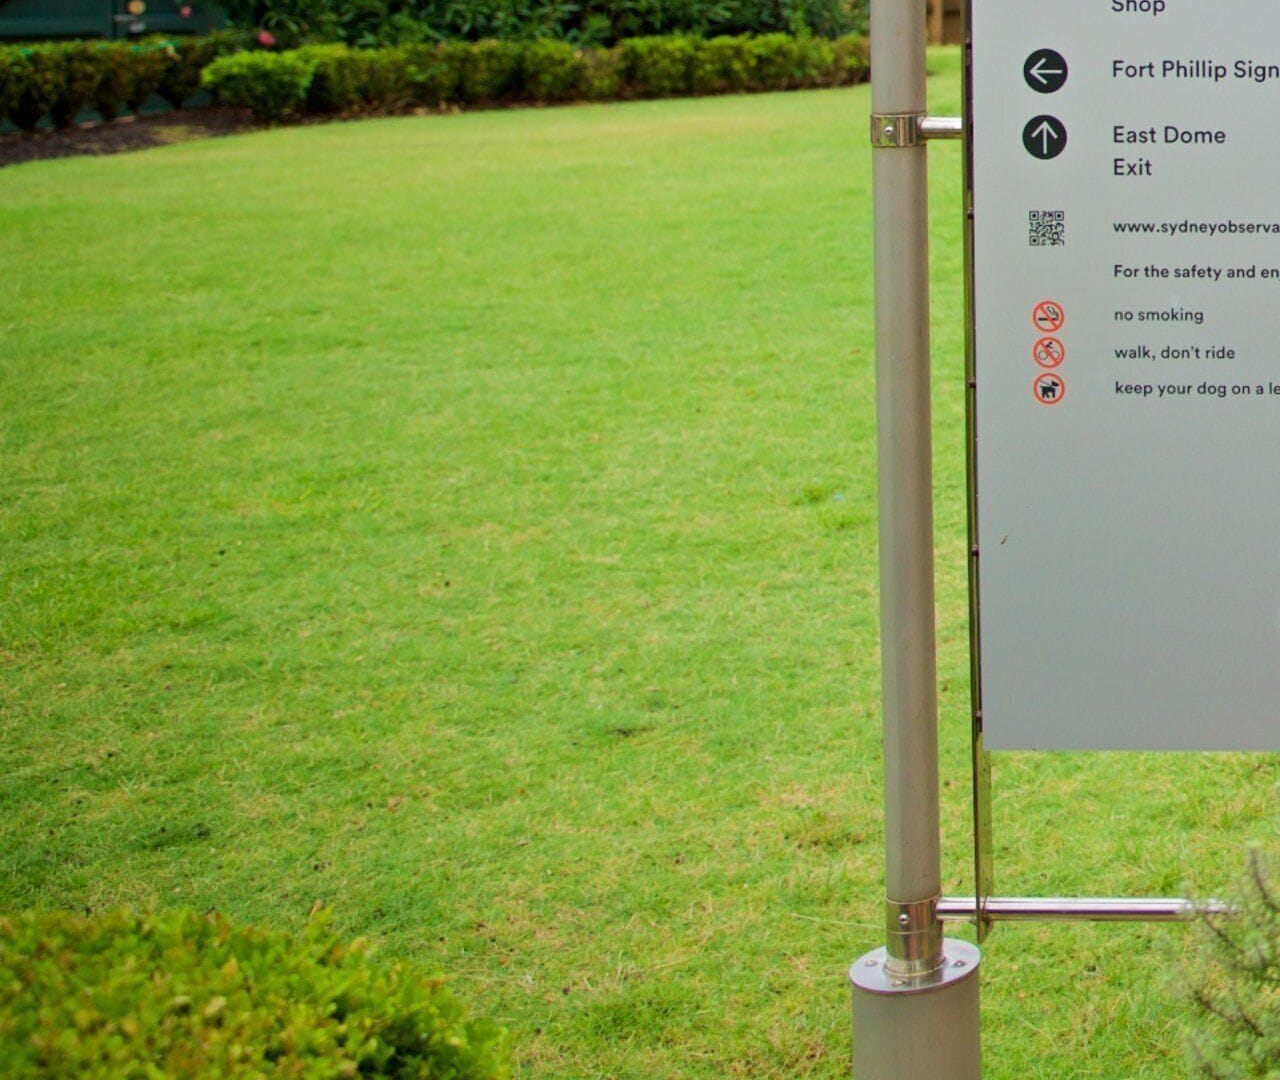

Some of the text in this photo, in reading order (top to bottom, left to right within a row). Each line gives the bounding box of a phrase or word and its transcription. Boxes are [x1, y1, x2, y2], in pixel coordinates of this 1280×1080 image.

[1112, 59, 1155, 79] Fort
[1162, 59, 1228, 83] Phillip
[1113, 125, 1226, 144] East Dome
[1113, 157, 1152, 177] Exit
[1113, 264, 1140, 279] For
[1143, 264, 1170, 279] the
[1173, 264, 1222, 282] safety
[1226, 264, 1256, 279] and
[1113, 307, 1204, 325] no smoking
[1113, 345, 1157, 361] walk,
[1205, 345, 1236, 360] ride
[1114, 380, 1154, 398] keep
[1157, 384, 1193, 398] your
[1196, 380, 1227, 398] dog
[1230, 384, 1251, 397] on
[1254, 384, 1265, 396] a
